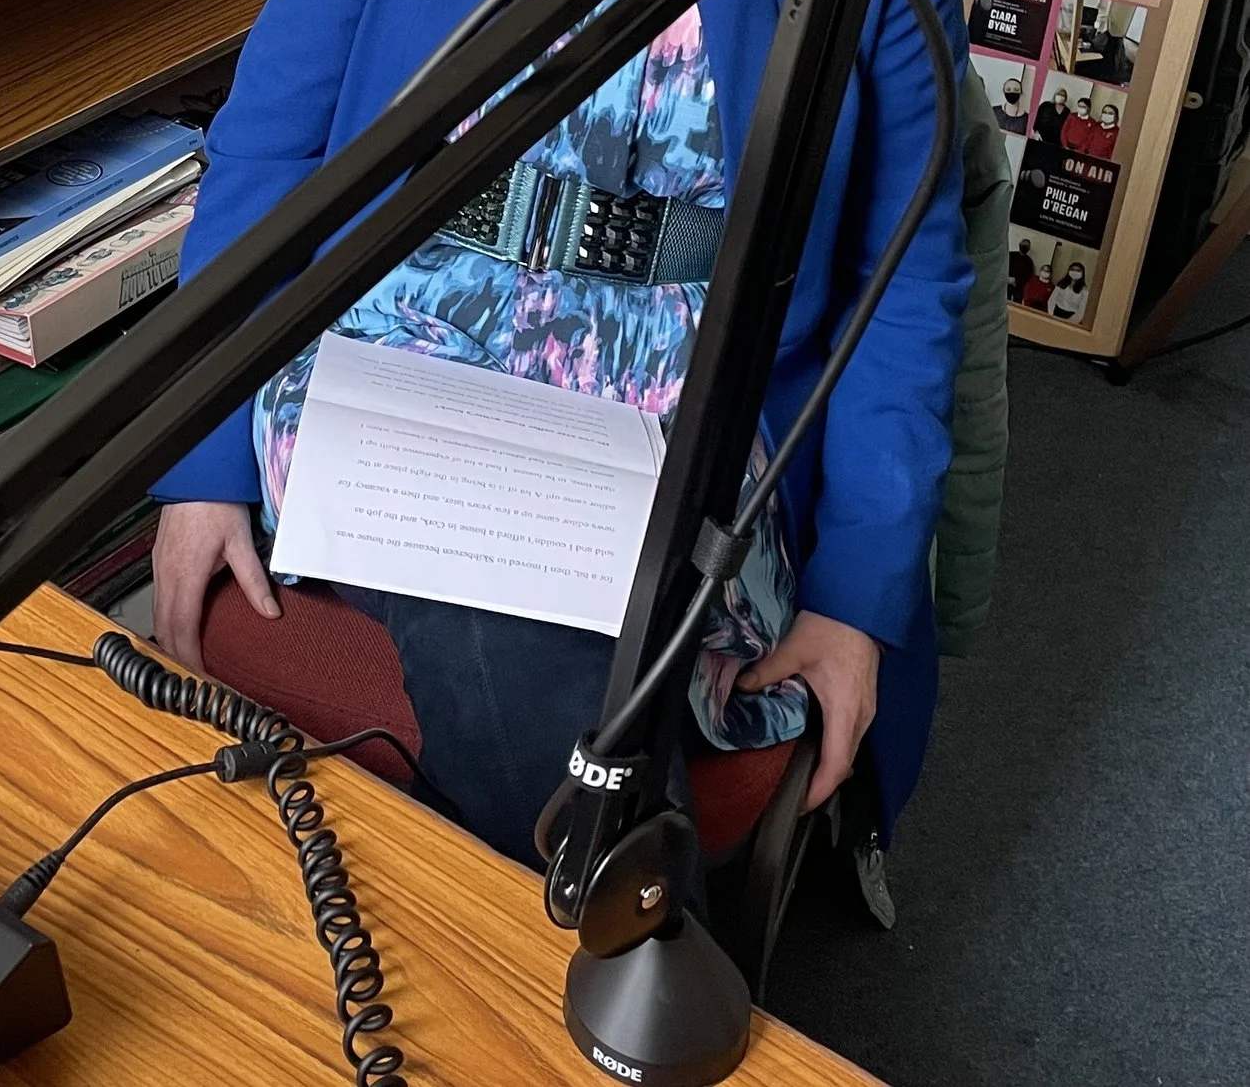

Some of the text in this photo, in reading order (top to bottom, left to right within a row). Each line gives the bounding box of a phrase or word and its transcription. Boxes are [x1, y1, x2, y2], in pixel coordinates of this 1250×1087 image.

[987, 19, 1018, 35] BYRNE
[990, 9, 1017, 24] CIARA
[1064, 158, 1085, 175] ON
[1087, 166, 1113, 184] AIR
[1045, 186, 1080, 205] PHILIP
[1042, 198, 1089, 222] O'REGAN
[592, 1046, 643, 1083] RØDE
